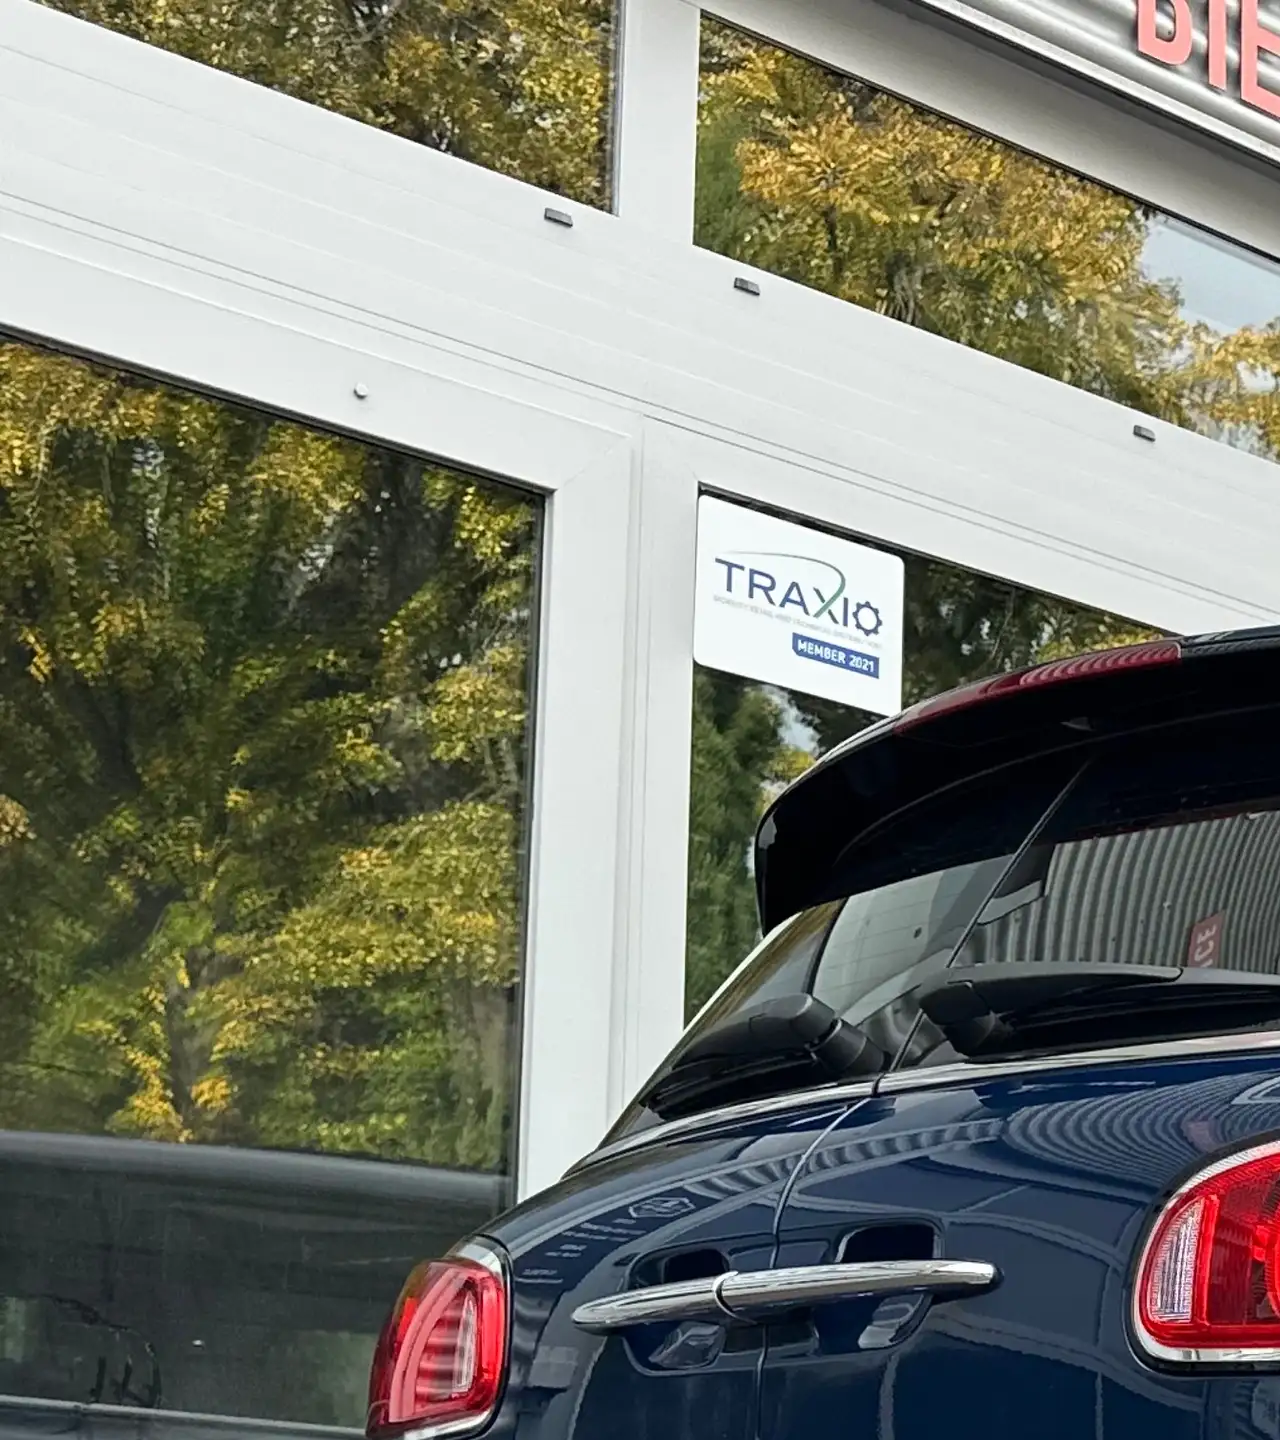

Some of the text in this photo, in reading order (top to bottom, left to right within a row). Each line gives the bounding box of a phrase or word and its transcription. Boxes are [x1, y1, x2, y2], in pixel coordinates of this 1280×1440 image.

[715, 557, 883, 637] TRAXIO
[797, 639, 875, 673] MEMBER 2021
